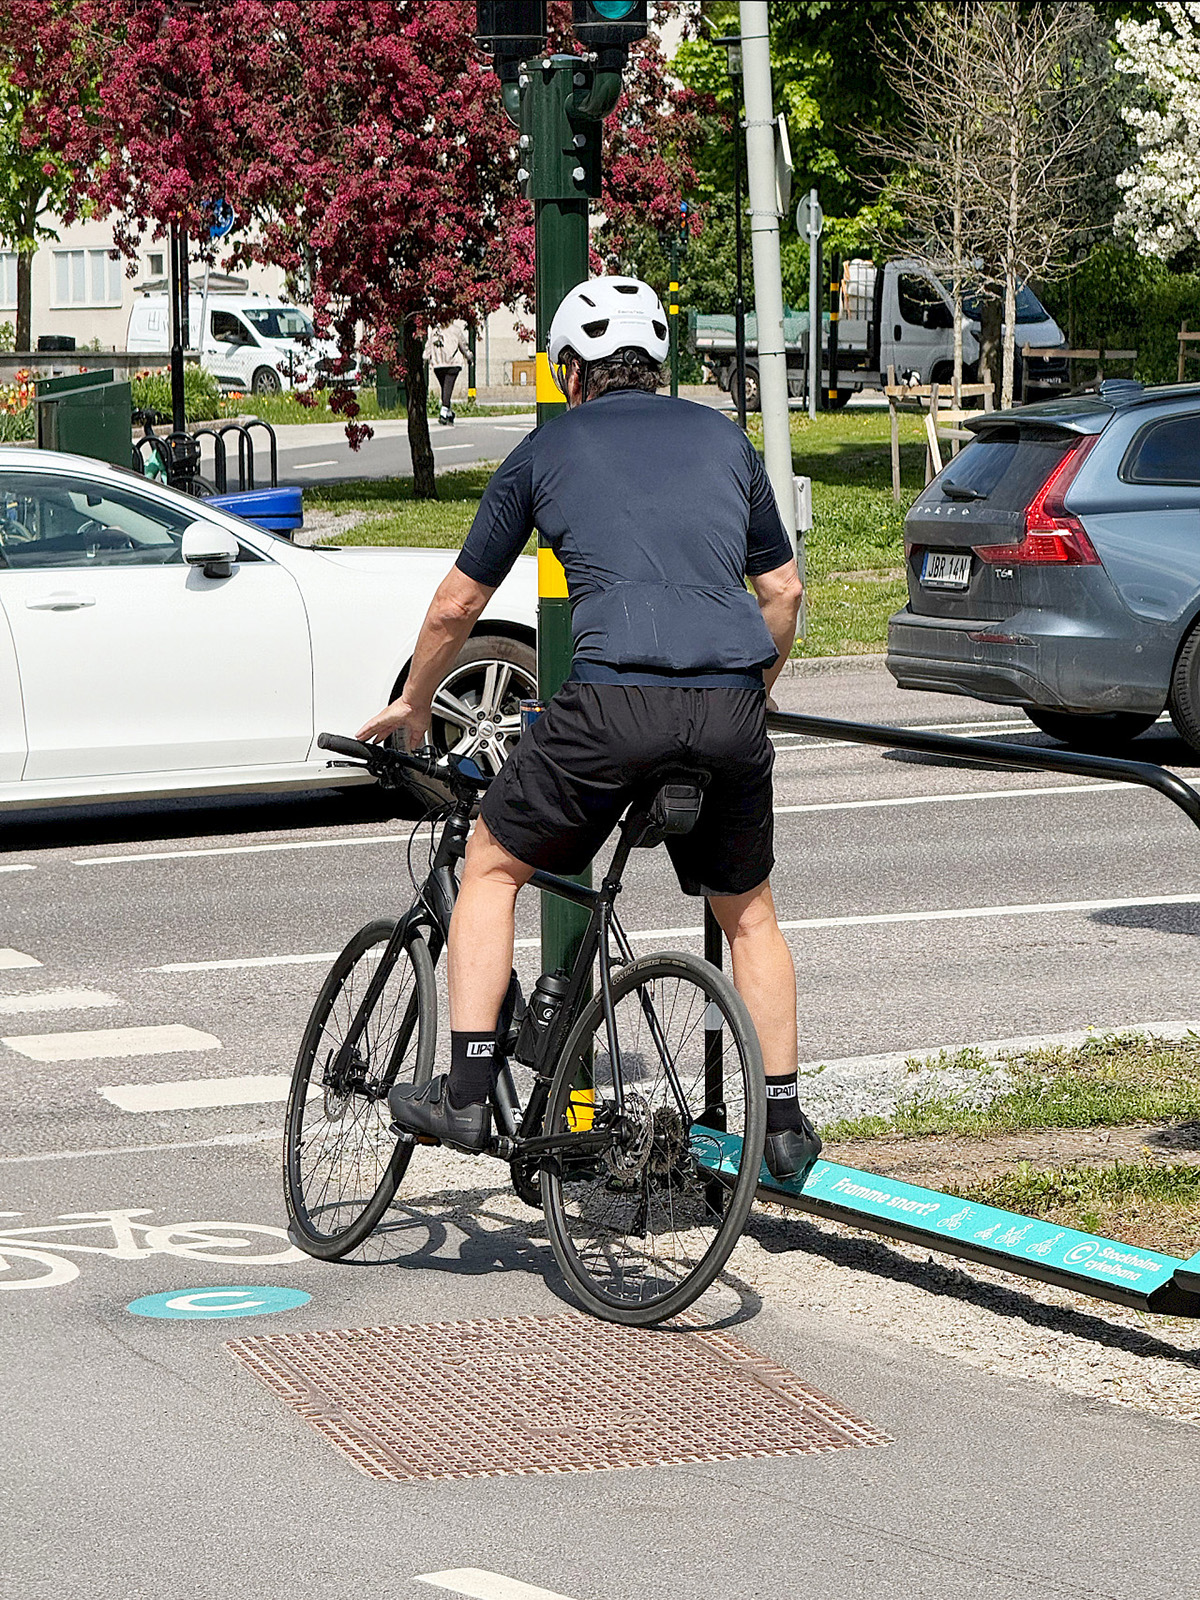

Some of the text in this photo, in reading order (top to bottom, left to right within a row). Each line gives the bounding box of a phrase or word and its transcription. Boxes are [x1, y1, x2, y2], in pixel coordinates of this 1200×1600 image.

[928, 556, 968, 581] JBR 14N
[612, 964, 638, 986] CONTACT
[830, 1177, 941, 1216] Framme snart?
[1084, 1260, 1143, 1281] cykelbana
[1098, 1246, 1163, 1272] Stockholms
